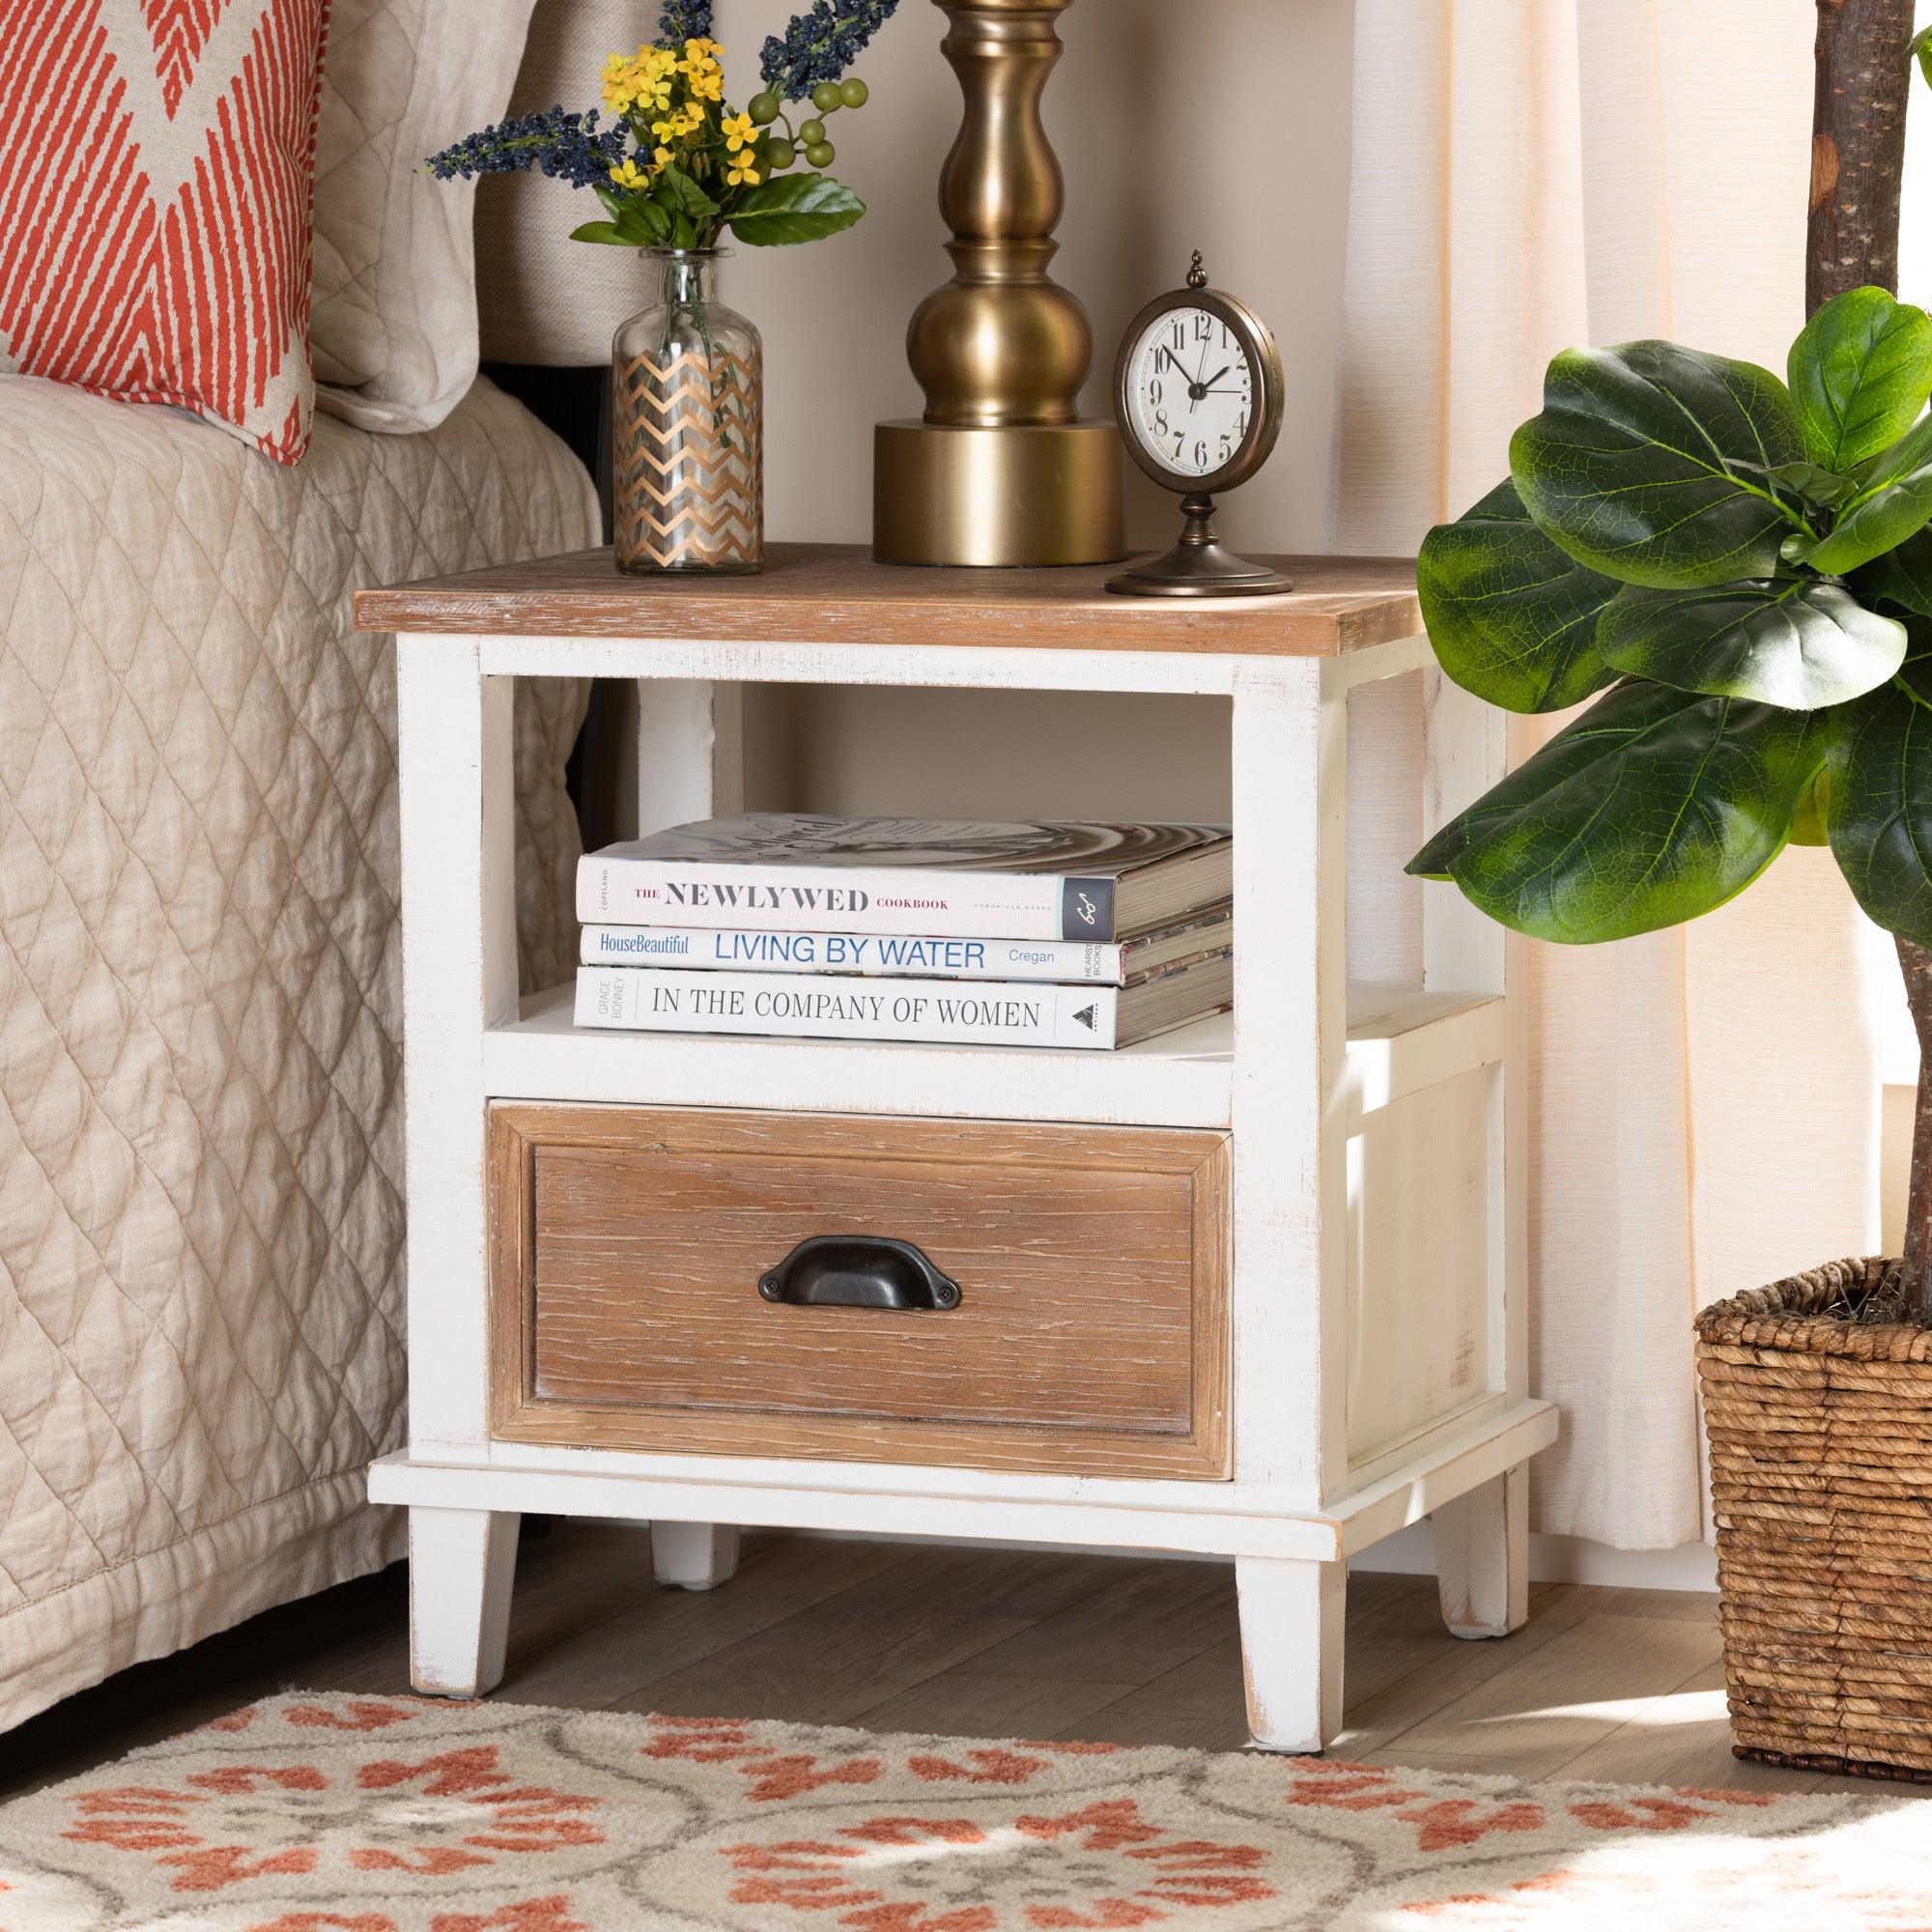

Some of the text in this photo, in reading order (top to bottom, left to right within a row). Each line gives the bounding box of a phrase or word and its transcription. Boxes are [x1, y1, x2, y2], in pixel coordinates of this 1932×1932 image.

[1174, 323, 1185, 350] 11
[1194, 315, 1211, 341] 12
[1221, 323, 1228, 349] 1
[1154, 348, 1171, 375] 10
[1151, 379, 1162, 406] 9
[1241, 378, 1252, 405] 3
[1154, 409, 1168, 436] 8
[1233, 411, 1247, 438] 4
[1174, 431, 1185, 457] 7
[1194, 440, 1208, 468] 6
[1219, 434, 1231, 462] 5
[634, 882, 950, 912] THE NEWLYWED COOKBOOK
[600, 933, 690, 954] HouseBeautiful
[716, 933, 984, 969] LIVING BY WATER
[1009, 949, 1055, 964] Cregan
[1085, 943, 1094, 978] HEARST
[1094, 945, 1102, 976] BOOKS
[598, 980, 611, 1014] GRACE
[611, 977, 624, 1019] BONNEY
[652, 987, 1041, 1027] IN THE COMPANY OF WOMEN
